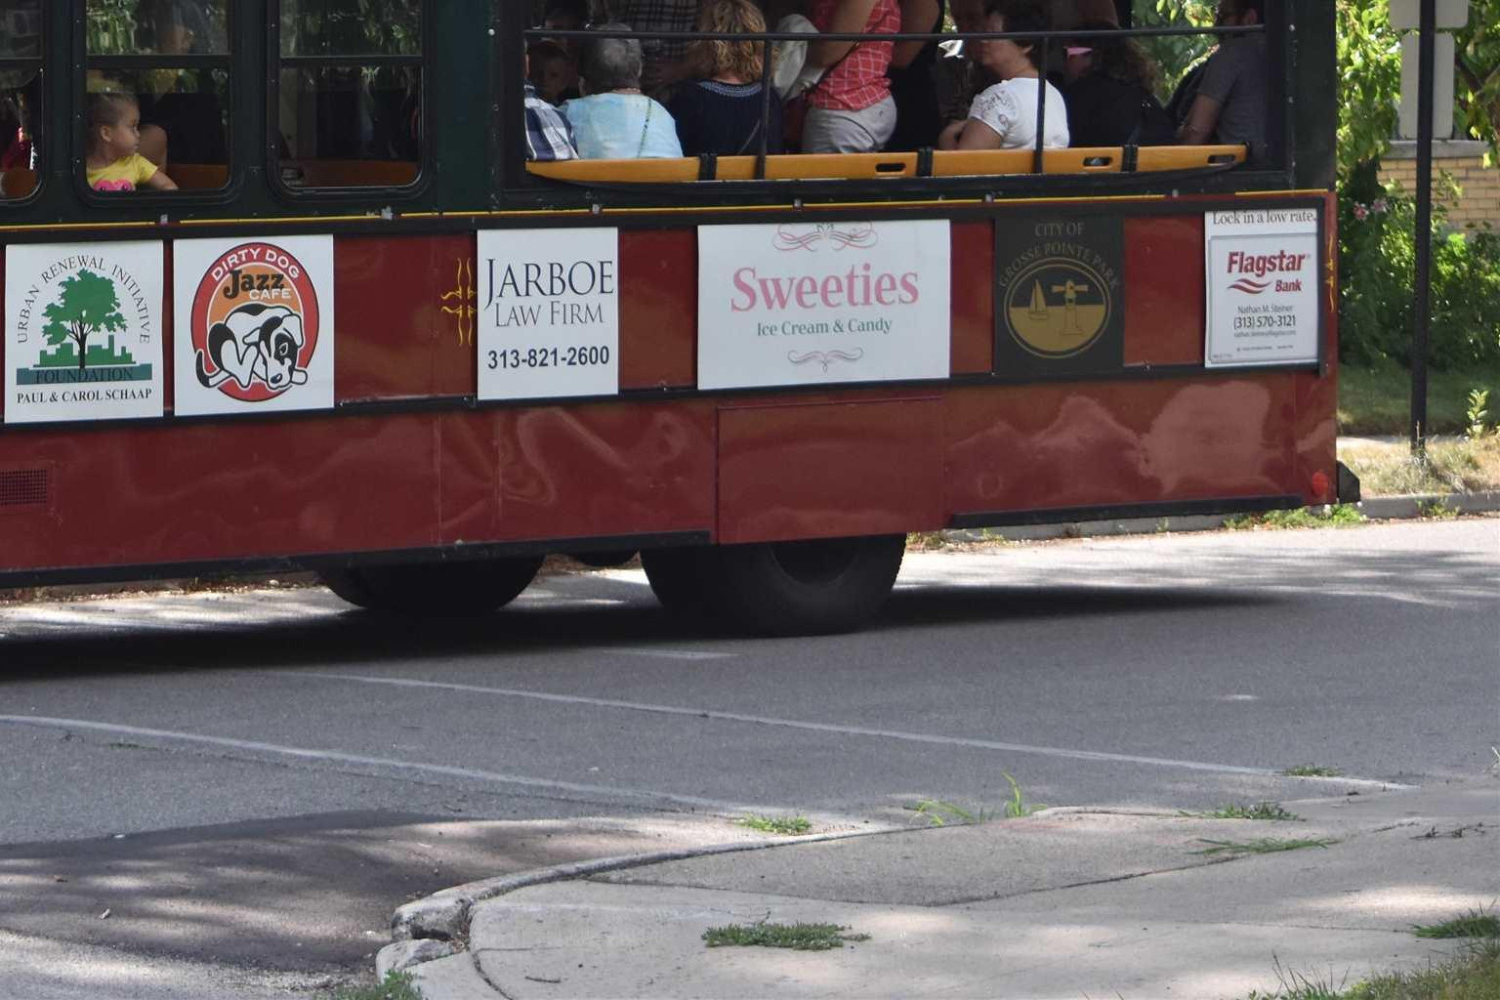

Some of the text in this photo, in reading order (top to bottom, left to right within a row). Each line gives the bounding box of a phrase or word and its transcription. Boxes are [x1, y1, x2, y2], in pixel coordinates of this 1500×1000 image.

[1213, 211, 1240, 225] Lock
[1243, 211, 1254, 224] in
[1257, 213, 1264, 224] a
[1267, 210, 1288, 223] low
[1035, 221, 1084, 237] CITY OF
[1044, 241, 1092, 262] POINTE
[211, 248, 299, 281] DIRTY DOG
[1227, 249, 1306, 278] Flagstar
[222, 269, 285, 299] Jazz
[248, 288, 292, 301] CAFE
[484, 258, 615, 311] JARBOE
[730, 262, 920, 312] Sweeties
[1274, 278, 1303, 293] Bank
[17, 254, 151, 345] URBAN RENEWAL INITIATIVE
[494, 299, 604, 328] LAW FIRM
[1233, 314, 1296, 330] (313) 570-3121
[757, 317, 893, 337] Ice Cream & Candy
[487, 345, 610, 370] 313-821-2600
[35, 367, 133, 384] FOUNDATION
[17, 388, 152, 404] PAUL & CAROL SCHAAP
